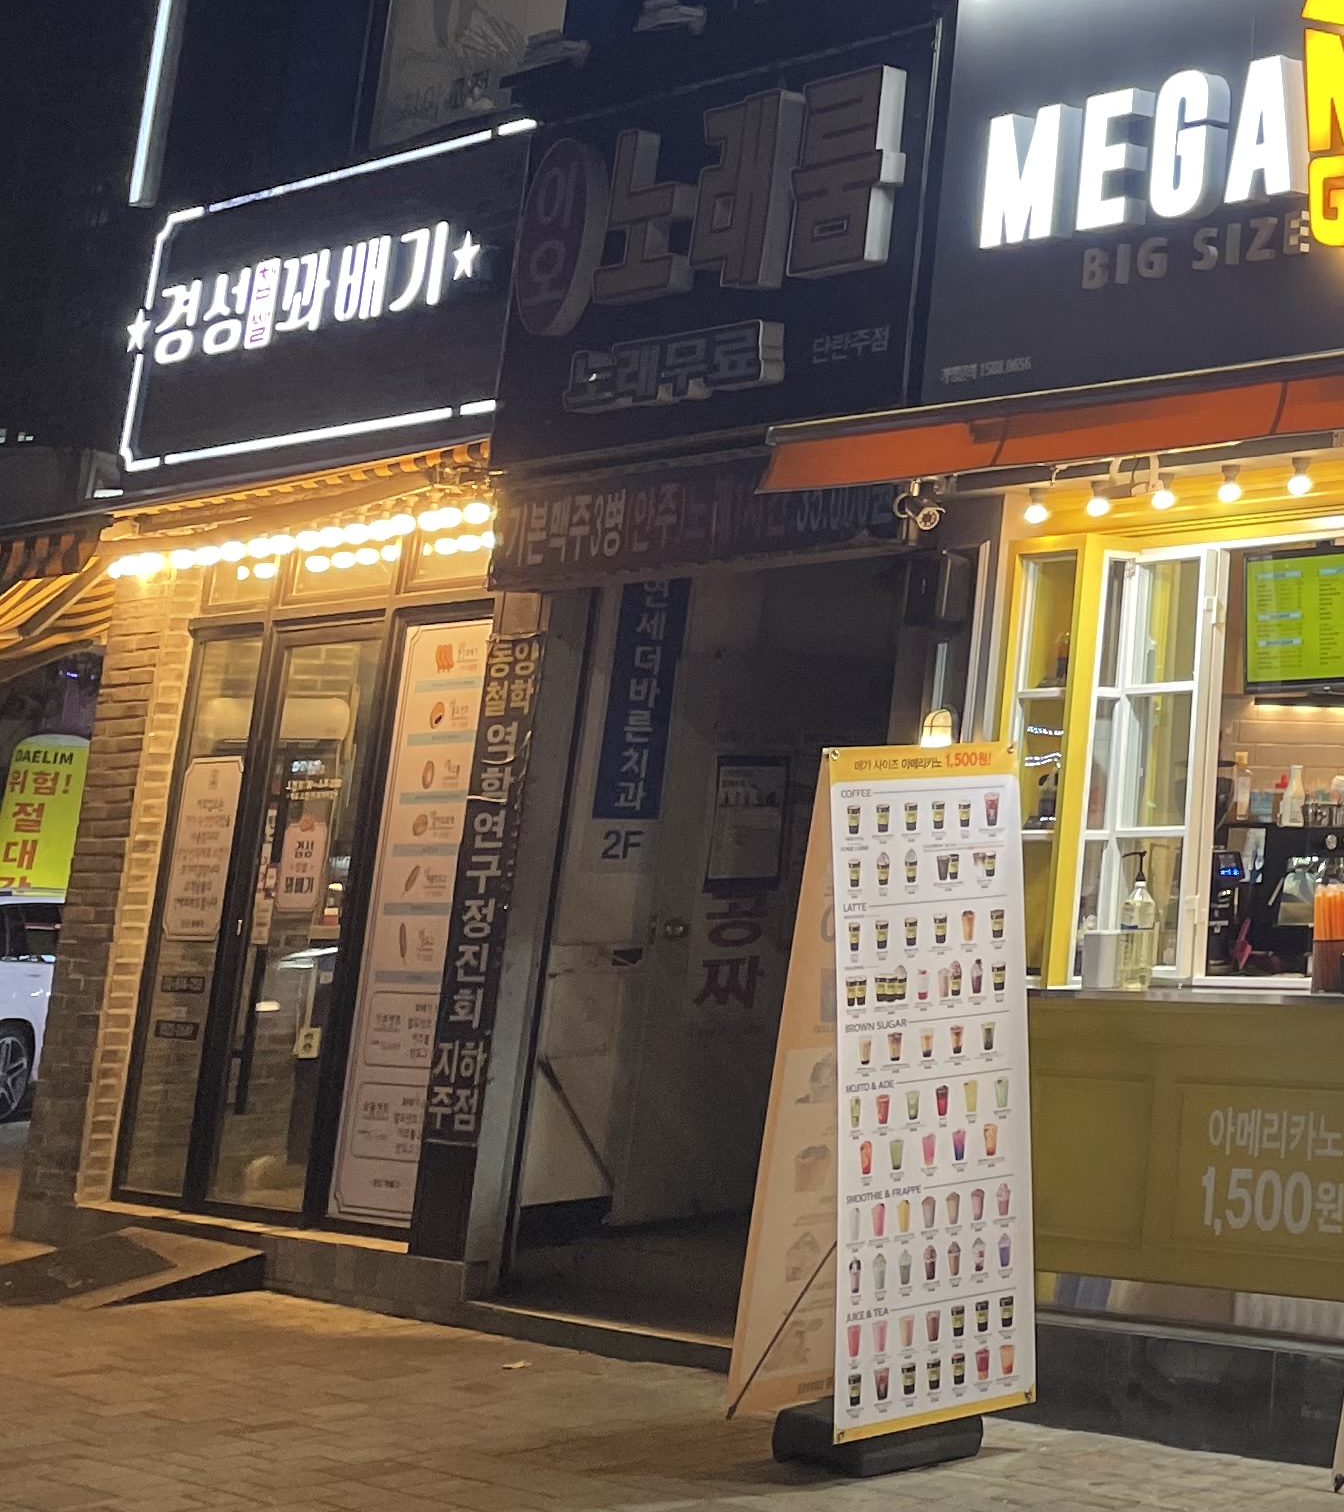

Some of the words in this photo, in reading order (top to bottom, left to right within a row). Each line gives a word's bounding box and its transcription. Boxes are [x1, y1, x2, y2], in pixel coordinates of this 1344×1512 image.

[979, 52, 1305, 250] MEGA
[594, 66, 905, 306] 노래룸
[1080, 229, 1183, 290] BIG
[1191, 212, 1311, 270] SIZE
[155, 266, 252, 365] 경성
[275, 220, 450, 332] 꽈배기
[812, 326, 893, 364] 단란주점
[565, 330, 762, 412] 노래무료
[614, 579, 670, 813] 연세더바른치과
[14, 748, 74, 766] DAELIM
[9, 770, 72, 797] 위험!
[840, 789, 872, 799] COFFEE
[600, 830, 645, 860] 2F
[842, 901, 868, 913] LATTE
[845, 1020, 876, 1034] BROWN
[877, 1018, 908, 1031] SUGAR
[1208, 1106, 1344, 1161] 아메리카노
[845, 1310, 865, 1324] JUICE
[873, 1307, 890, 1318] TEA
